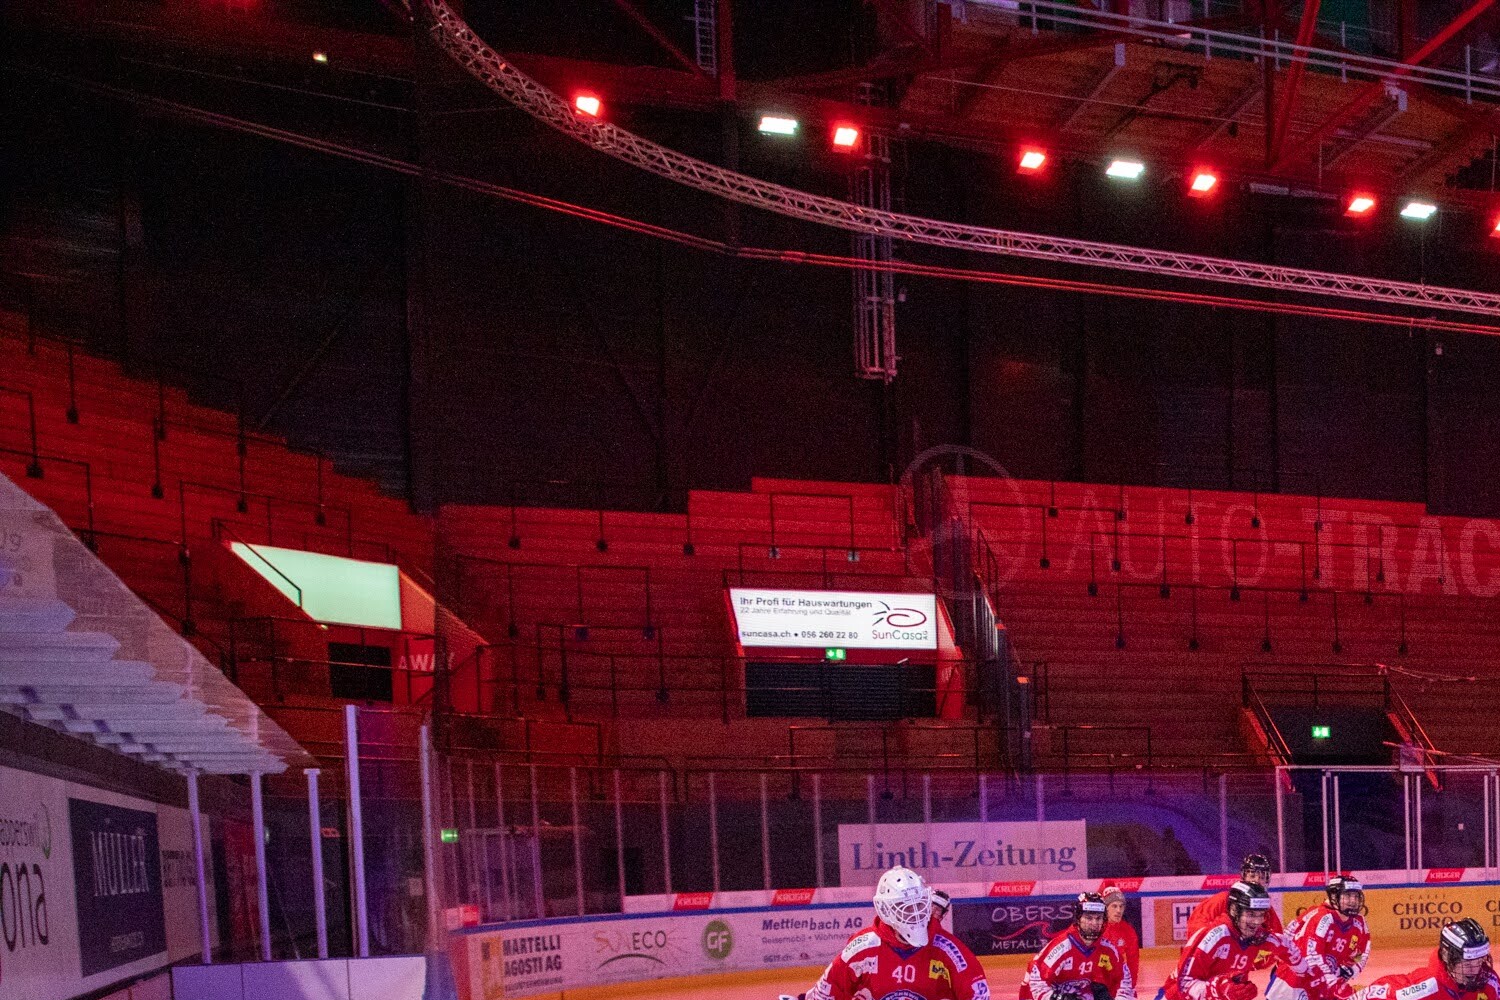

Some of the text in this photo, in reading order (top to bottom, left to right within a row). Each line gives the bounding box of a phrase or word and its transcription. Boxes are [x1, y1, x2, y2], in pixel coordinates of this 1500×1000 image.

[740, 597, 872, 610] Ihr Profi für Hauswartungen
[742, 629, 791, 638] suncasa.ch
[801, 631, 817, 639] 056
[836, 631, 847, 640] 22
[872, 629, 923, 641] SunCasa
[851, 839, 1077, 872] Linth-Zeitung
[991, 905, 1074, 922] OBERS
[1392, 901, 1463, 916] CHICCO
[844, 917, 863, 928] AG
[502, 934, 561, 956] MARTELLI
[706, 931, 729, 952] GF
[991, 938, 1049, 950] METALLB
[504, 954, 563, 977] AGOSTI AG
[1078, 961, 1094, 976] 43
[1230, 954, 1248, 970] 19
[892, 964, 916, 984] 40
